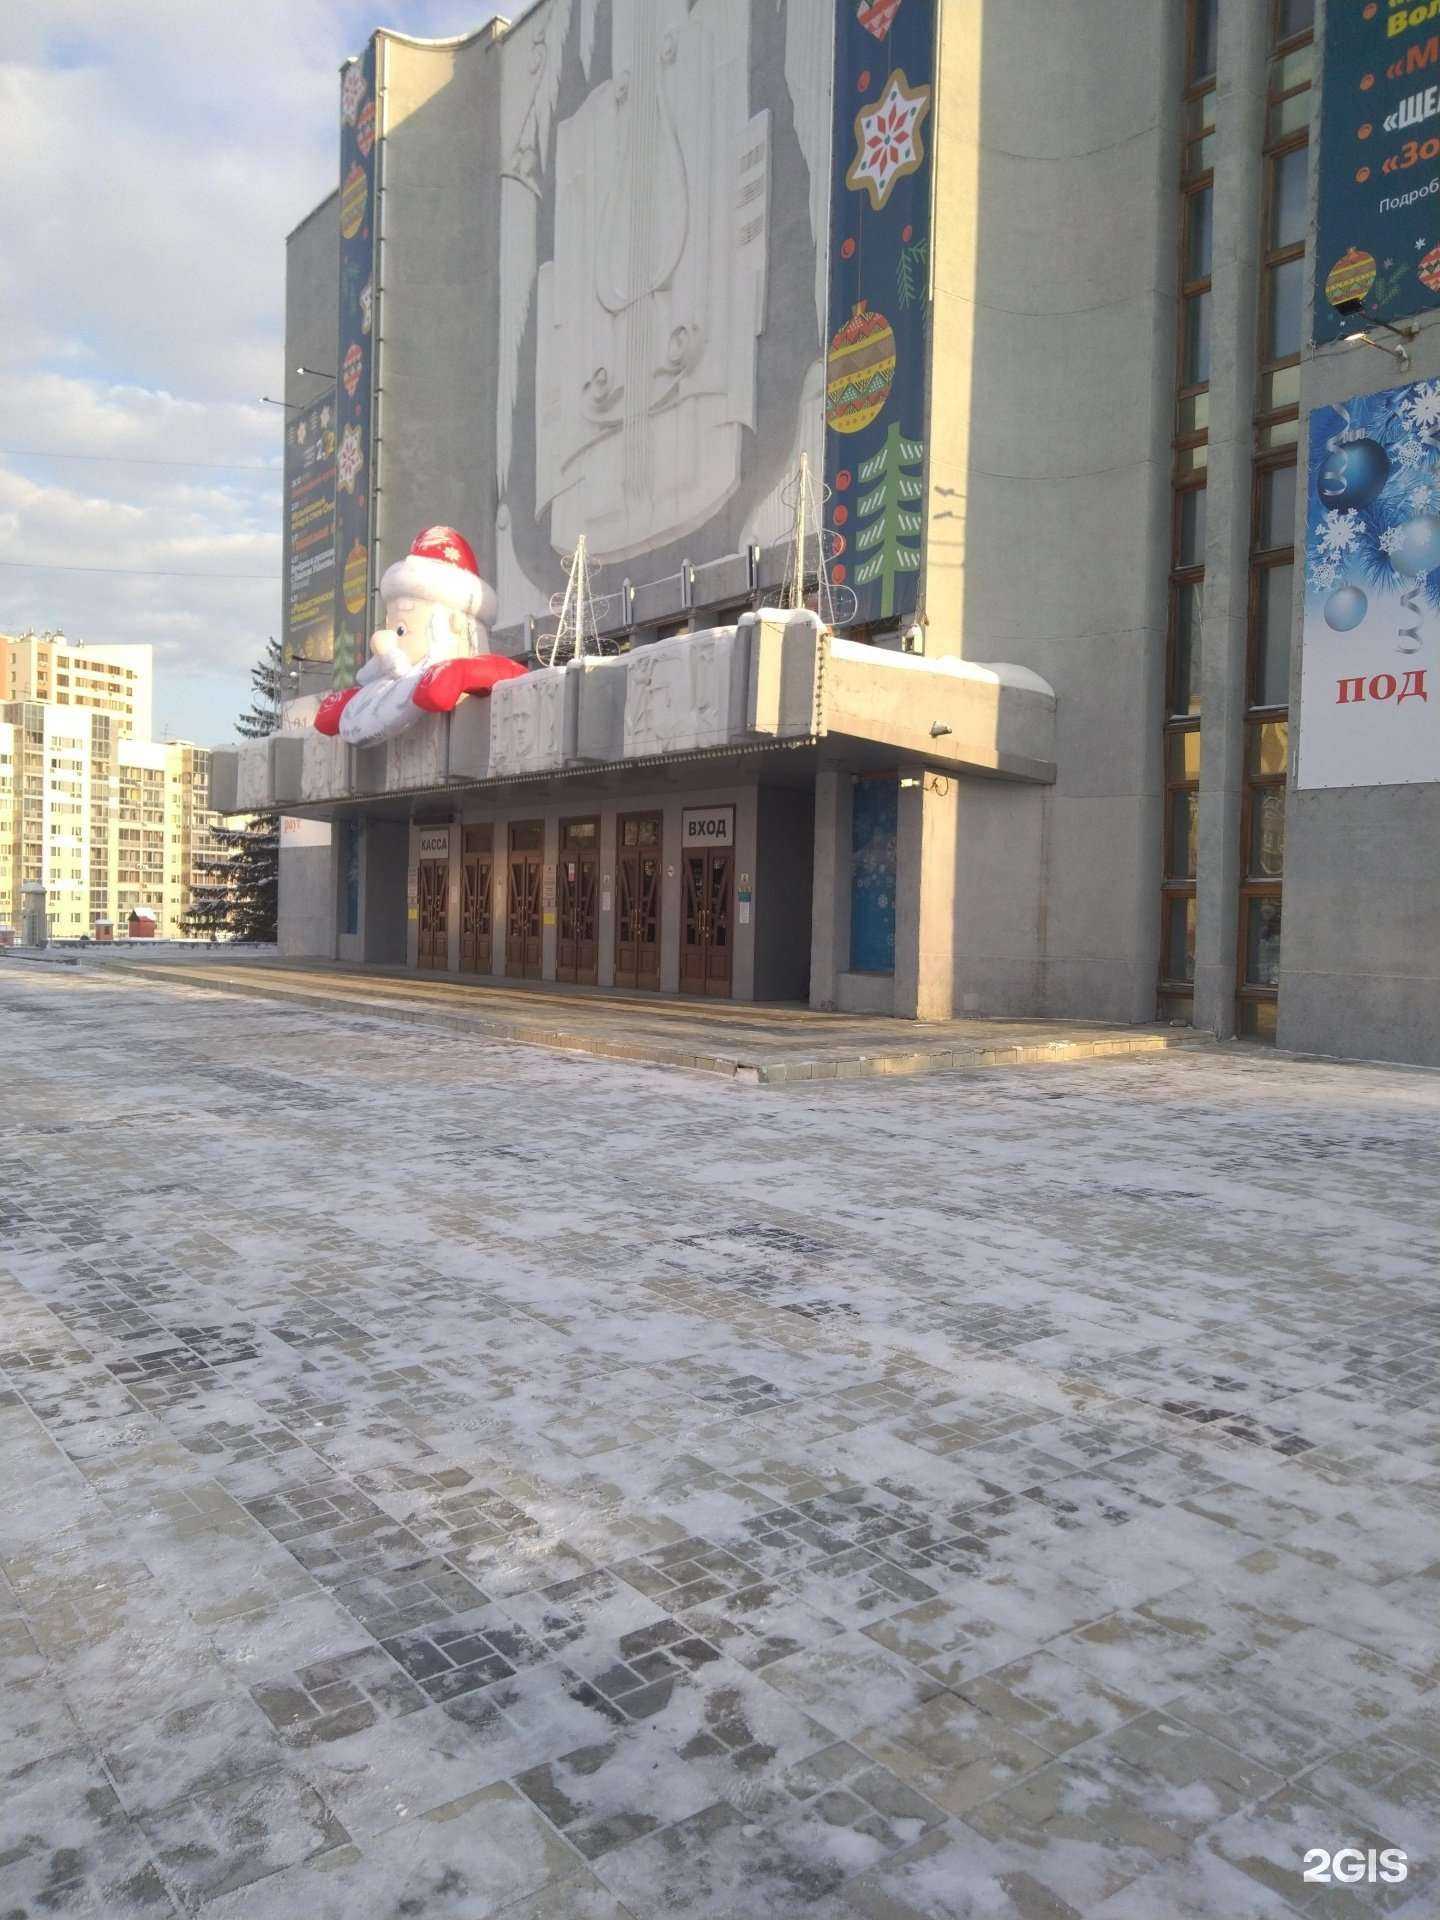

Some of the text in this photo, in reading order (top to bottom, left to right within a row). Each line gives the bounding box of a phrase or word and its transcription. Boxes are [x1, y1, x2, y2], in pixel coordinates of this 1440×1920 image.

[1383, 85, 1440, 132] «ЩЕ
[1379, 177, 1440, 214] Подроб
[688, 819, 727, 838] ВХОД
[421, 837, 448, 850] КАССА
